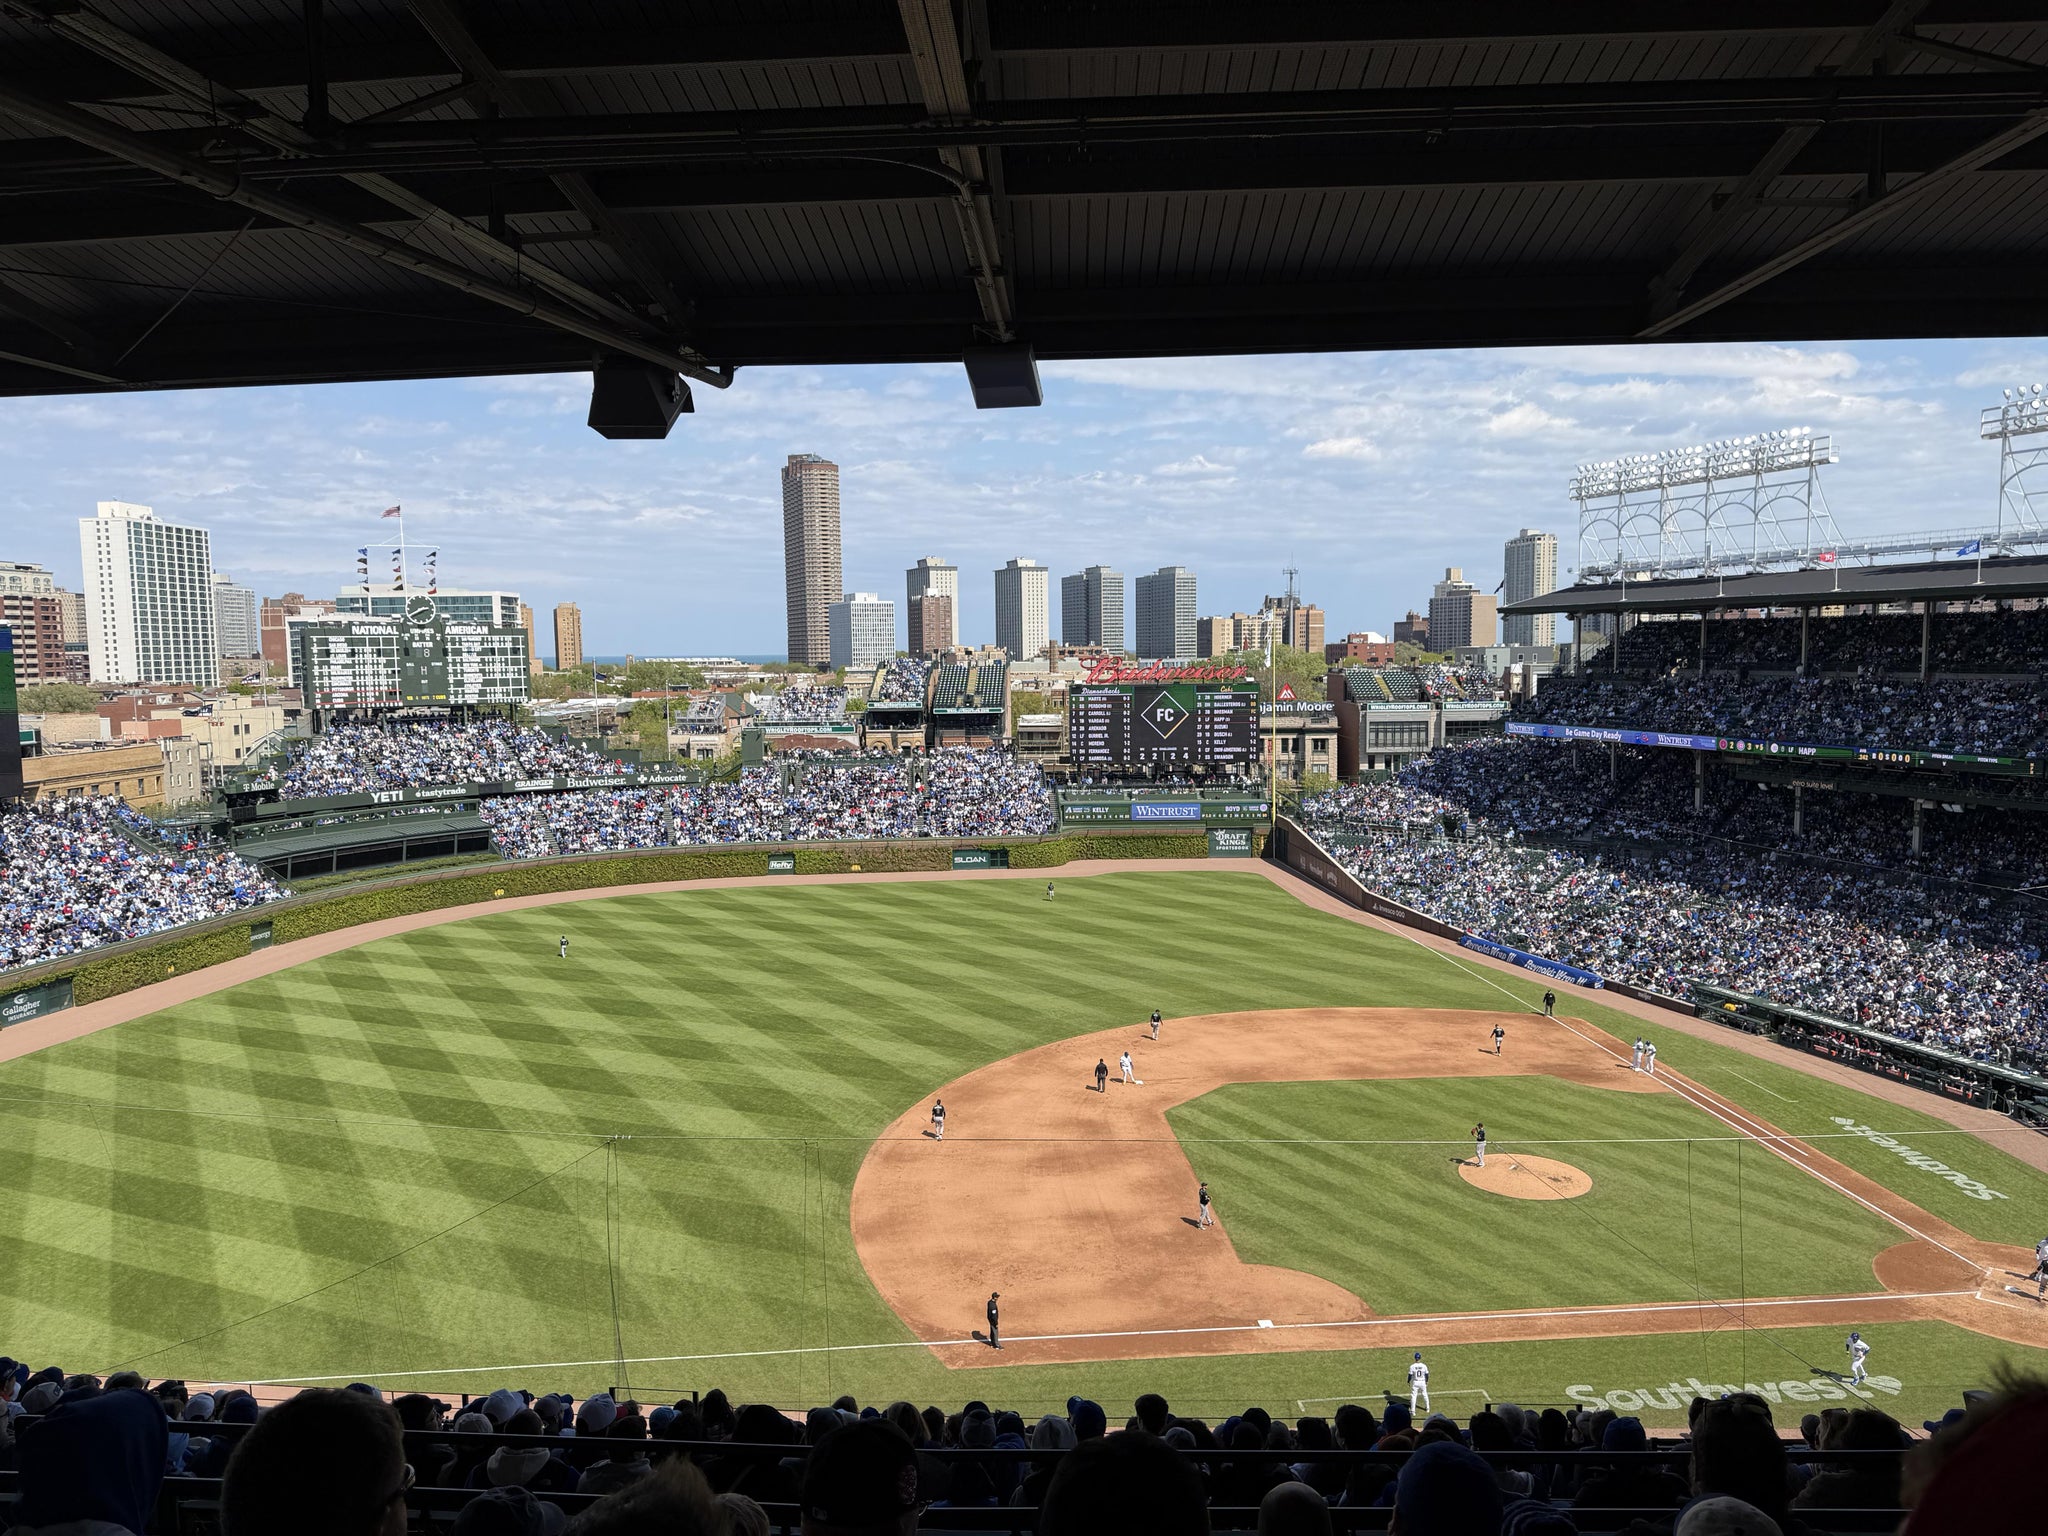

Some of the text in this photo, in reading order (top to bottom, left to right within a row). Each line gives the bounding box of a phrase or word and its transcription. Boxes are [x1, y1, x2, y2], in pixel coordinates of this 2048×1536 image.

[352, 626, 399, 634] NATIONAL
[445, 626, 488, 634] AMERICAN
[1080, 656, 1248, 684] Budweiser
[1297, 702, 1333, 711] Moore
[1157, 708, 1174, 721] FC
[1574, 729, 1590, 737] Game
[1592, 730, 1602, 739] Day
[1603, 731, 1622, 740] Ready
[1798, 747, 1816, 755] HAPP
[515, 779, 554, 788] GRAINGER
[649, 775, 686, 783] Advocate
[251, 781, 274, 790] Mobile
[371, 791, 403, 803] YETI
[422, 787, 466, 798] tastytrade
[1136, 805, 1198, 816] WINTRUST
[1464, 939, 1491, 955] Reynolds
[1524, 959, 1555, 978] Reynolds
[2, 1000, 40, 1016] Gallagher
[8, 1009, 37, 1022] INSURANCE
[1842, 1125, 2010, 1200] Southwest
[1565, 1378, 1874, 1412] Southwest
